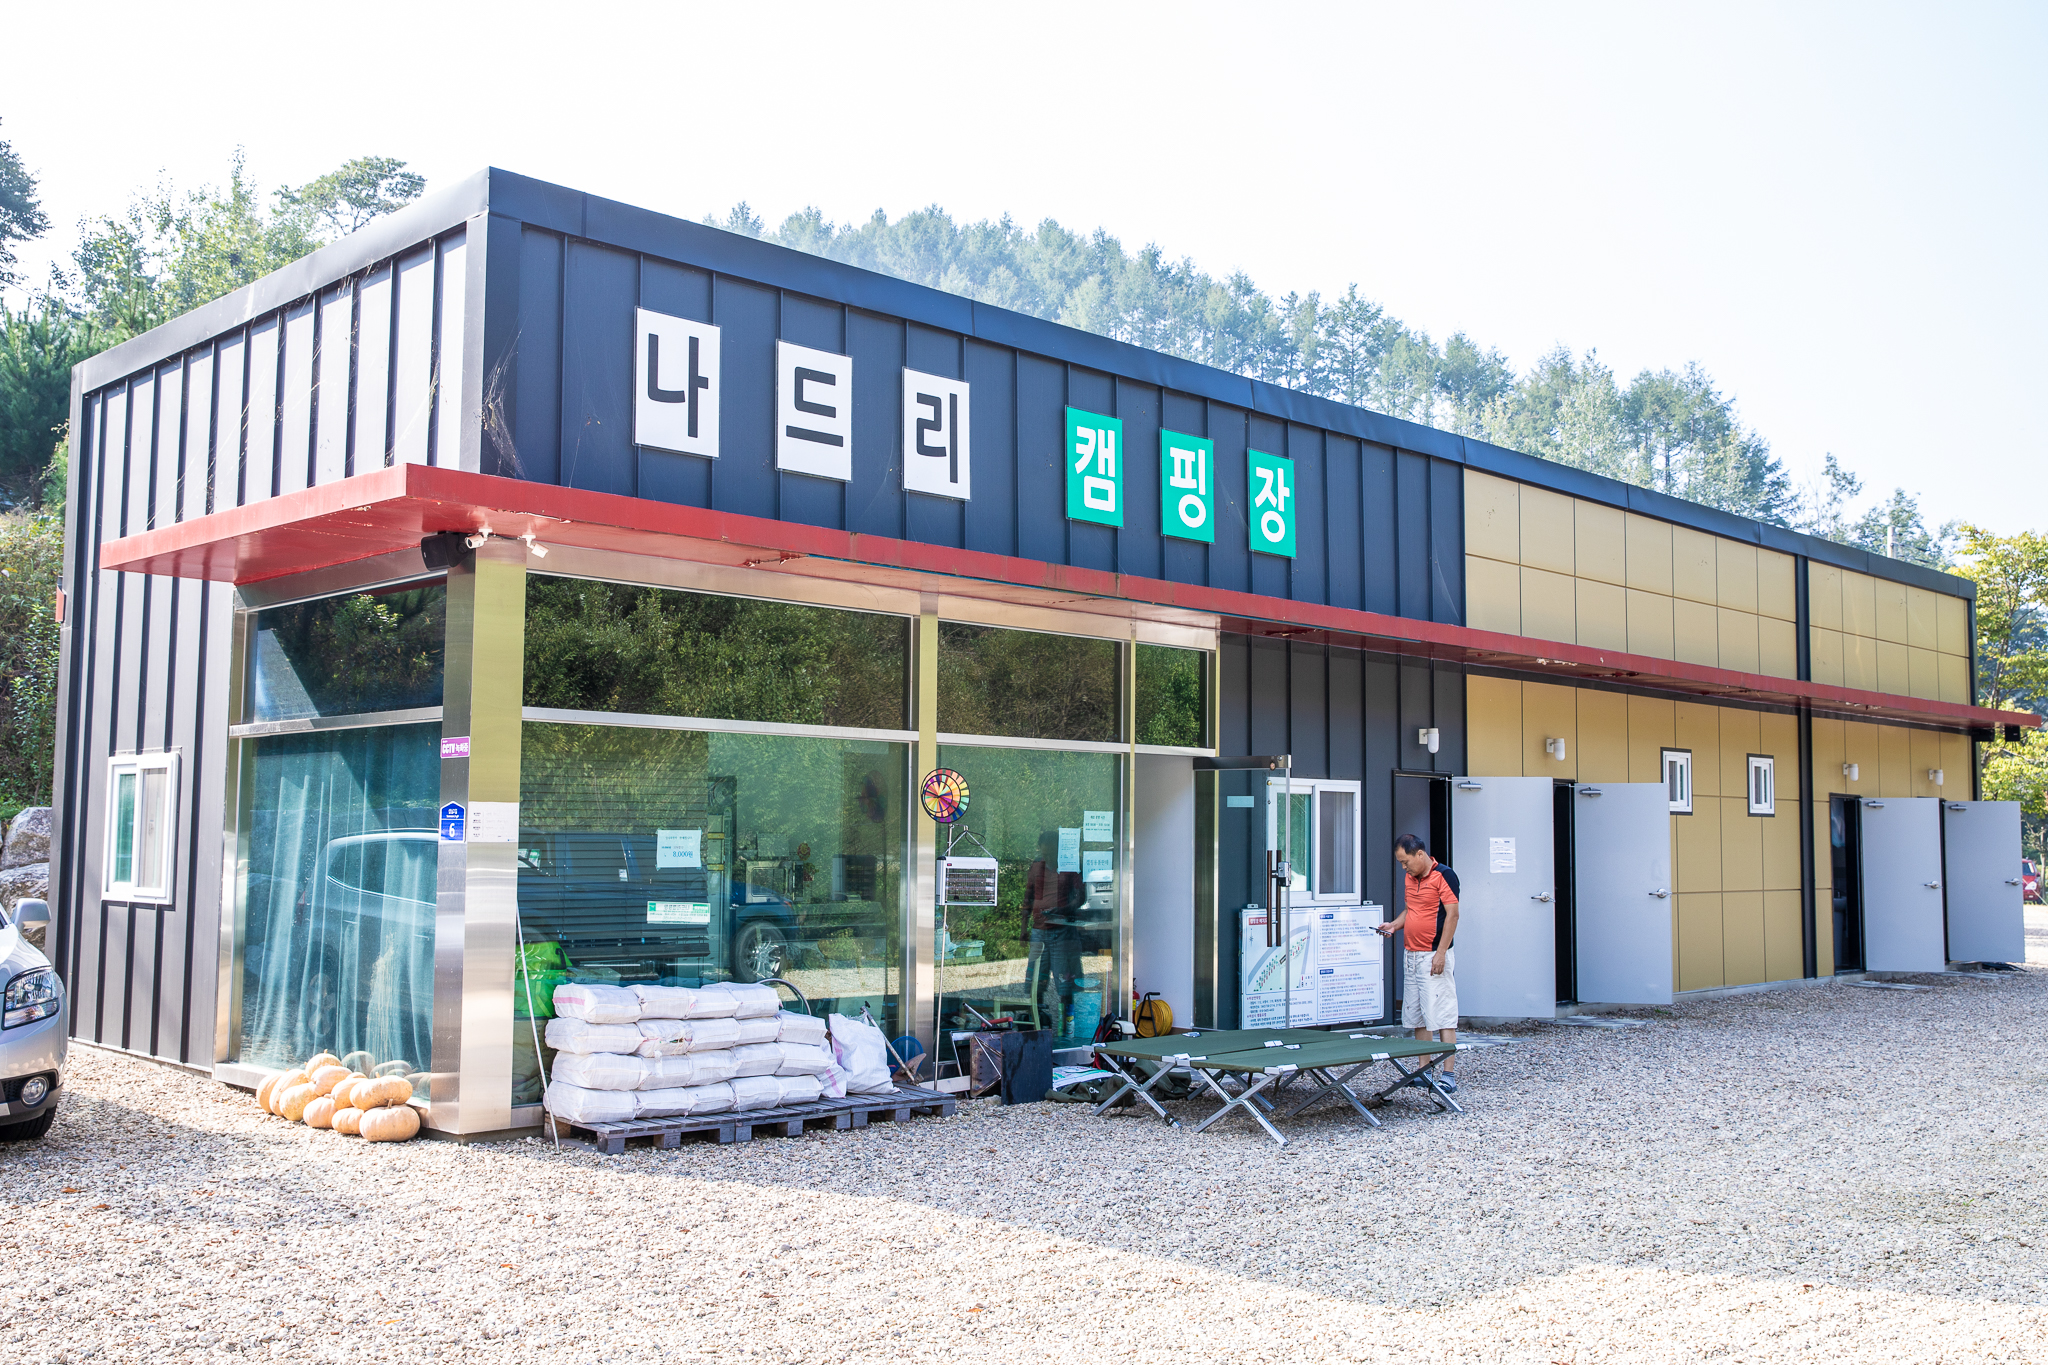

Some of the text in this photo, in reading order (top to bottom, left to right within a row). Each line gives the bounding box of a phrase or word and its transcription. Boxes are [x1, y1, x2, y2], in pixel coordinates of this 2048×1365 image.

[647, 333, 1290, 543] 나드리 캠핑장
[443, 743, 455, 754] CCTV
[449, 822, 455, 838] 6
